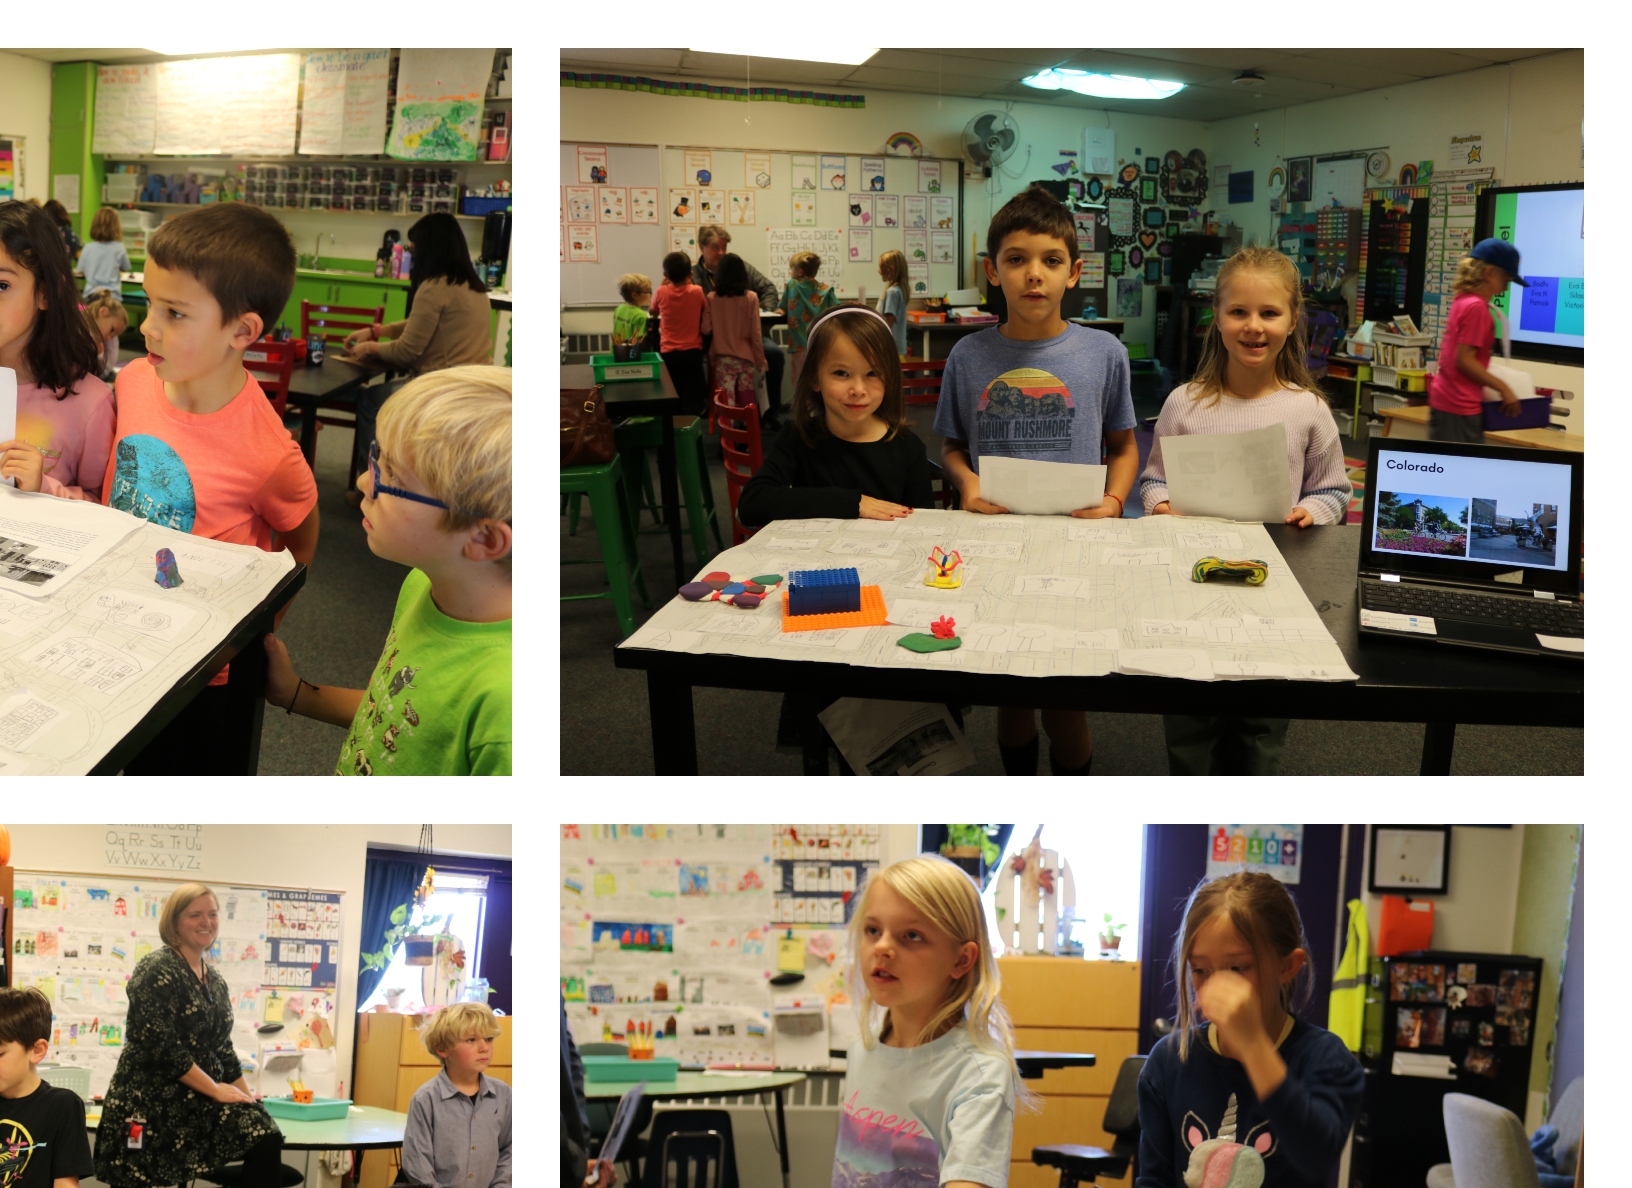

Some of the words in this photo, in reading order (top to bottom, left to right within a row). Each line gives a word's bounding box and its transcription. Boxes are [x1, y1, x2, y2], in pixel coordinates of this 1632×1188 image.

[1529, 298, 1550, 306] Patrick
[1564, 300, 1584, 308] Victori
[977, 420, 1011, 439] MOUNT
[1013, 419, 1072, 439] RUSHMORE
[1386, 459, 1444, 474] Colorado
[105, 831, 127, 851] Qq
[129, 833, 145, 847] Rr
[150, 834, 164, 848] Ss
[170, 835, 181, 849] Tt
[185, 836, 202, 851] Uu
[1216, 837, 1228, 852] 5
[1234, 838, 1243, 853] 2
[1251, 840, 1260, 853] 1
[1266, 840, 1277, 855] 0
[105, 850, 120, 864] Vv
[123, 851, 149, 866] Ww
[150, 853, 167, 867] Xx
[168, 854, 184, 871] Yy
[187, 855, 201, 869] Zz
[843, 1090, 925, 1143] Aspen
